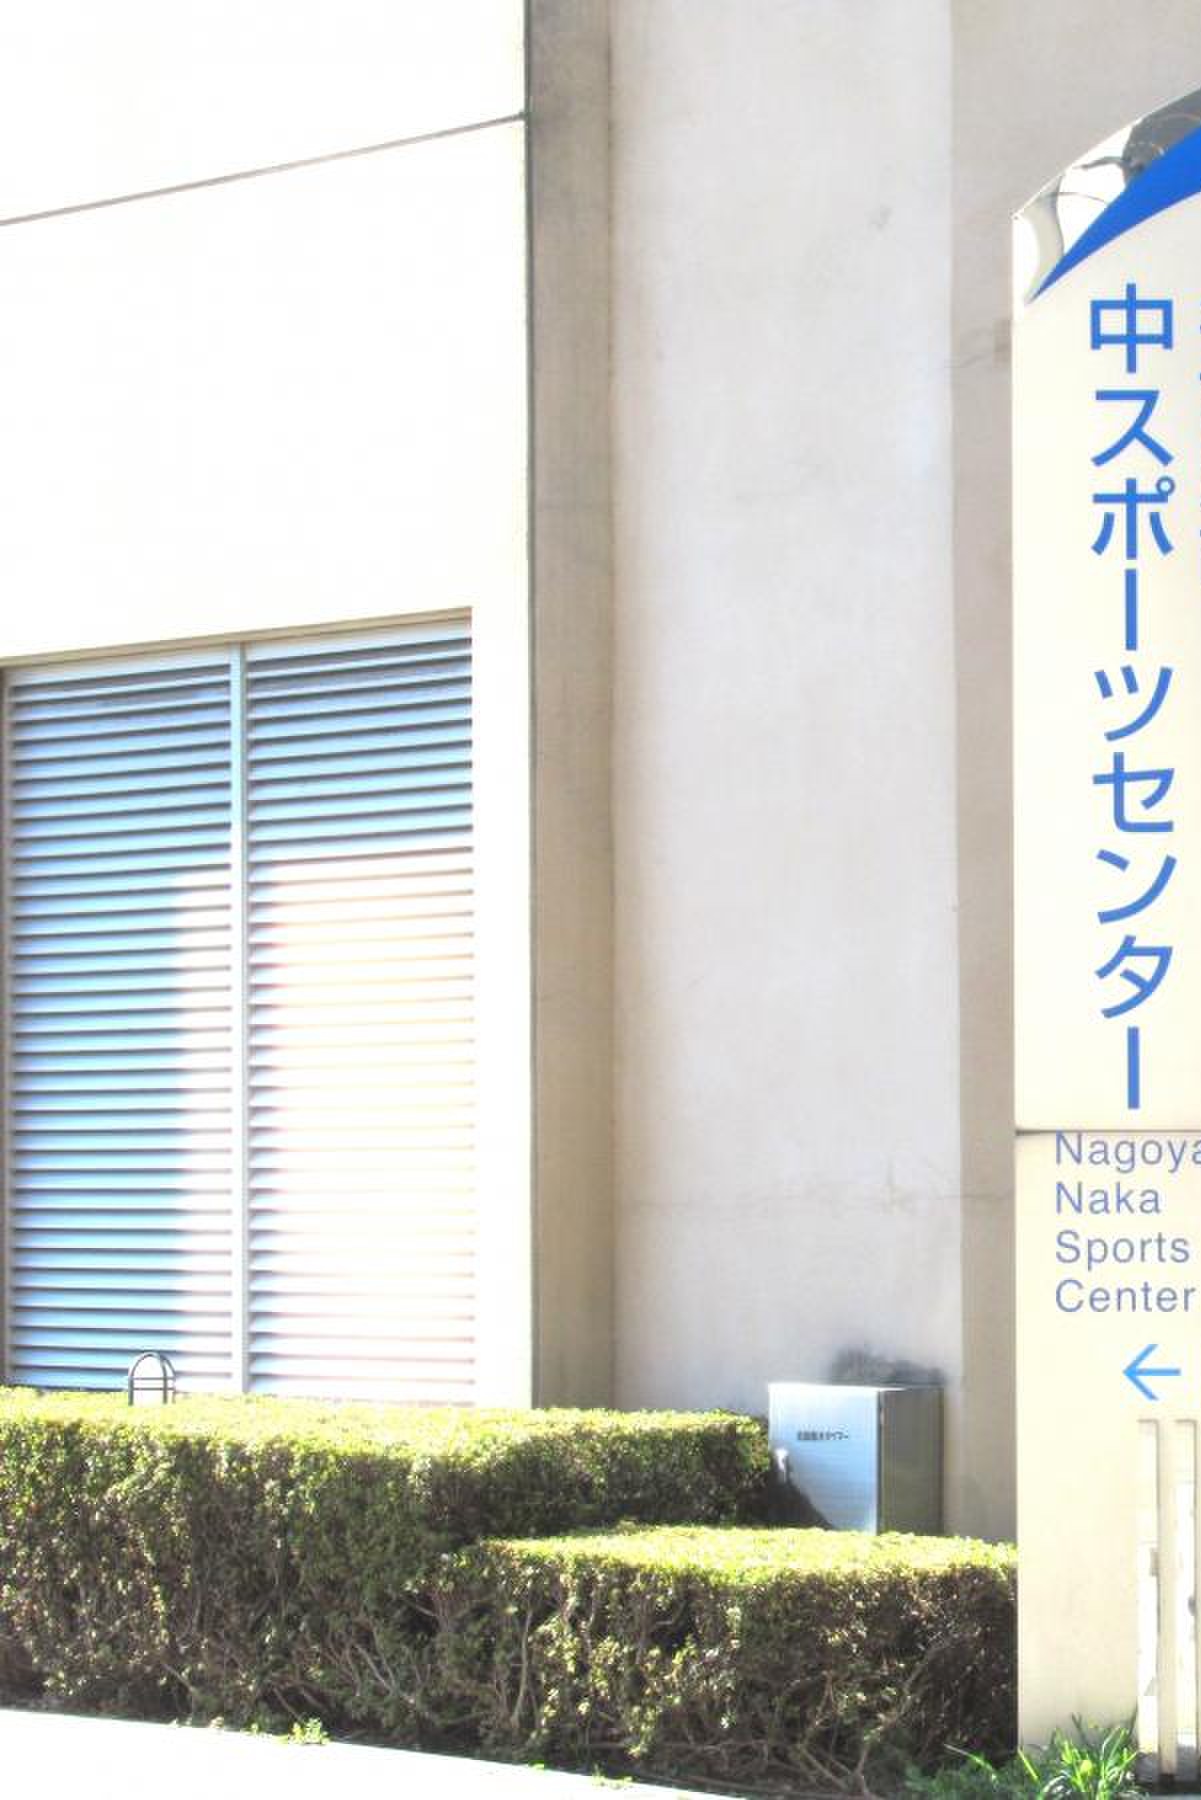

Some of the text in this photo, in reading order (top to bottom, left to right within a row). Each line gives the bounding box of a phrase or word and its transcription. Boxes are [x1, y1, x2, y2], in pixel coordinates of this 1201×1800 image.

[1090, 283, 1177, 1109] 中スポーツセンター
[1055, 1181, 1162, 1215] Naka
[1055, 1229, 1191, 1271] Sports
[1055, 1279, 1196, 1313] Center
